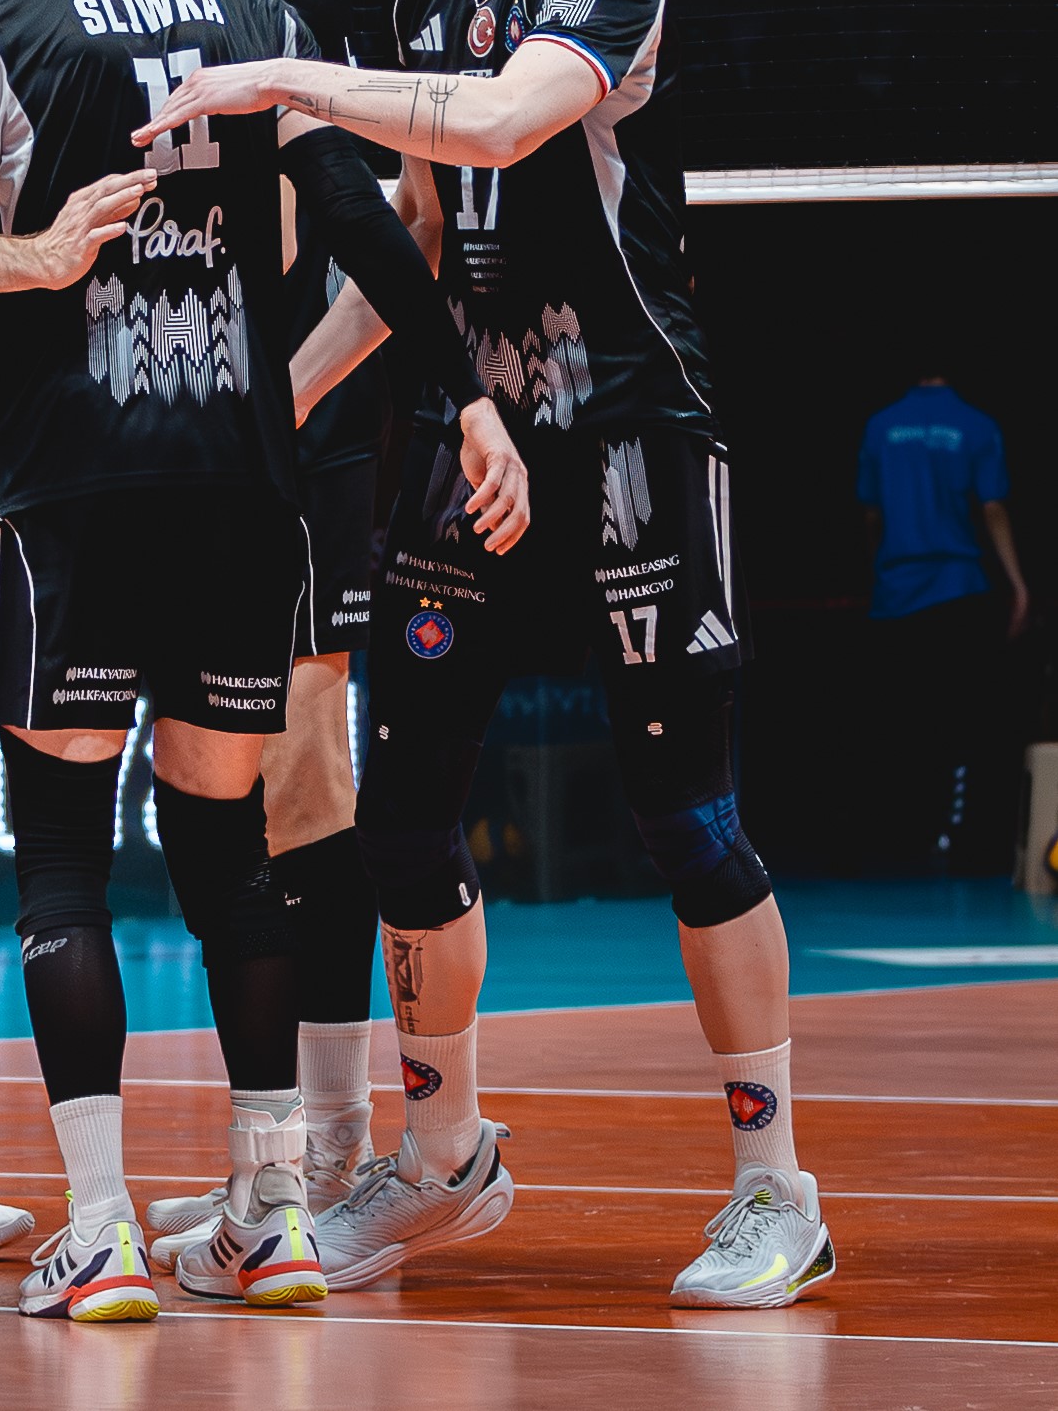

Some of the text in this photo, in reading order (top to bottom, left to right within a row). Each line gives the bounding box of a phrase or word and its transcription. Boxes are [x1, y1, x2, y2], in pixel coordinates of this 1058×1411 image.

[132, 47, 220, 176] 11
[606, 554, 680, 580] HALKLEASING
[618, 579, 674, 600] HALKGYO
[609, 604, 658, 666] 17
[212, 674, 282, 689] HALKLEASING
[220, 696, 276, 711] HALKGYO
